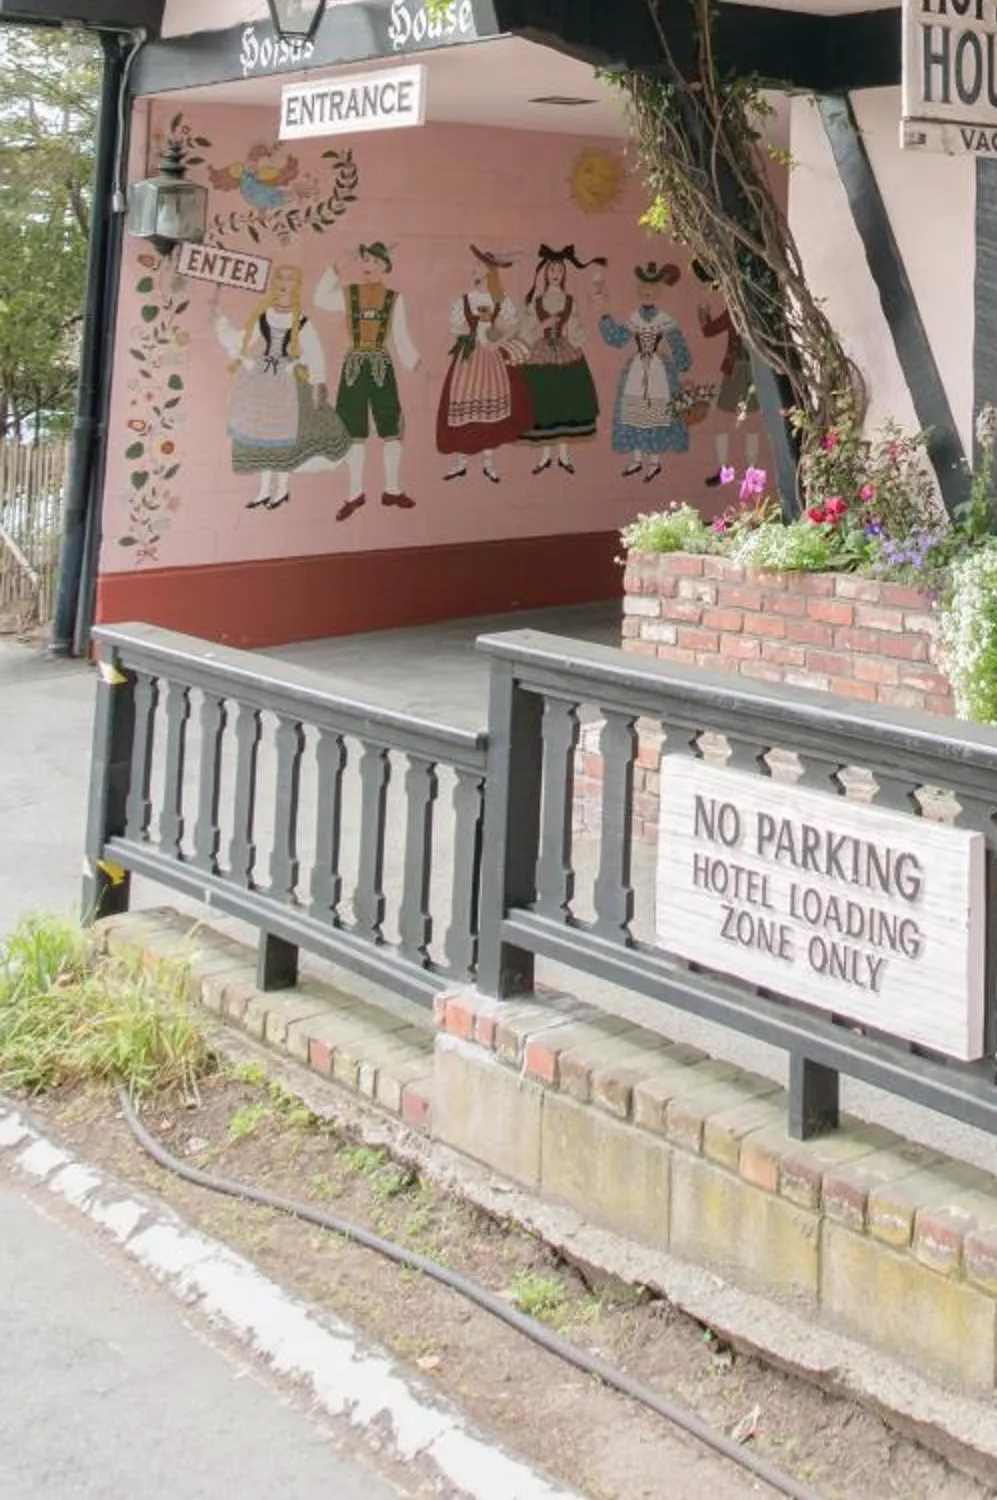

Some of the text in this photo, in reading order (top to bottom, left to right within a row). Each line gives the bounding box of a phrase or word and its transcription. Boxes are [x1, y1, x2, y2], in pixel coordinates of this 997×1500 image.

[285, 80, 414, 127] ENTRANCE
[187, 249, 258, 285] ENTER
[693, 794, 922, 903] NO PARKING
[693, 852, 922, 960] HOTEL LOADING
[720, 903, 884, 993] ZONE ONLY
